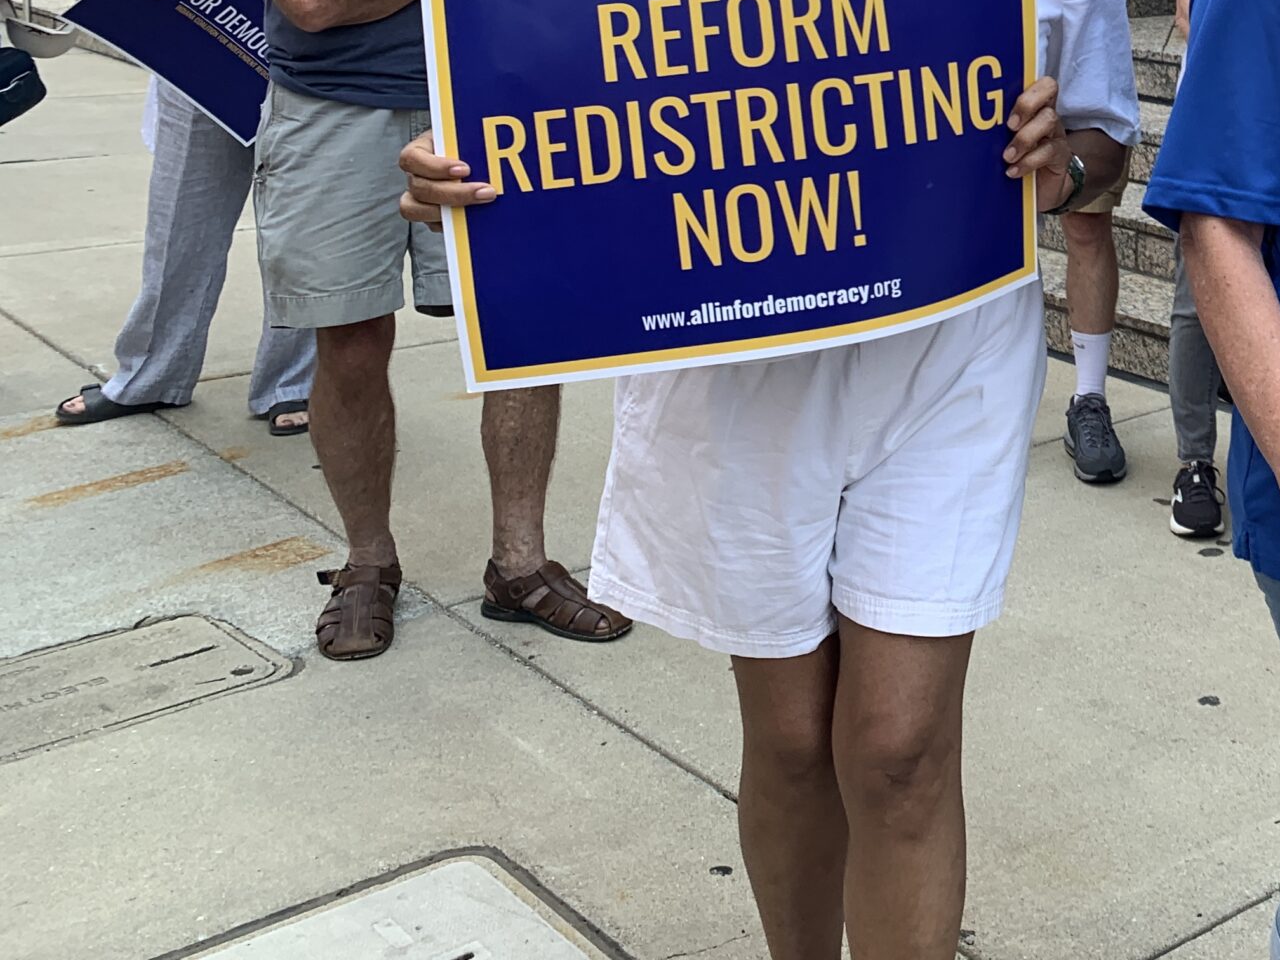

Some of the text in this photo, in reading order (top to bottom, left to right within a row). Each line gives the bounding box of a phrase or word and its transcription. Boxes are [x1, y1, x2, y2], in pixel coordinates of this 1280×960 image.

[214, 5, 270, 63] DEMOC
[481, 55, 1005, 195] REDISTRICTING
[672, 170, 867, 271] NOW!
[641, 278, 902, 331] www.allinfordemocracy.org
